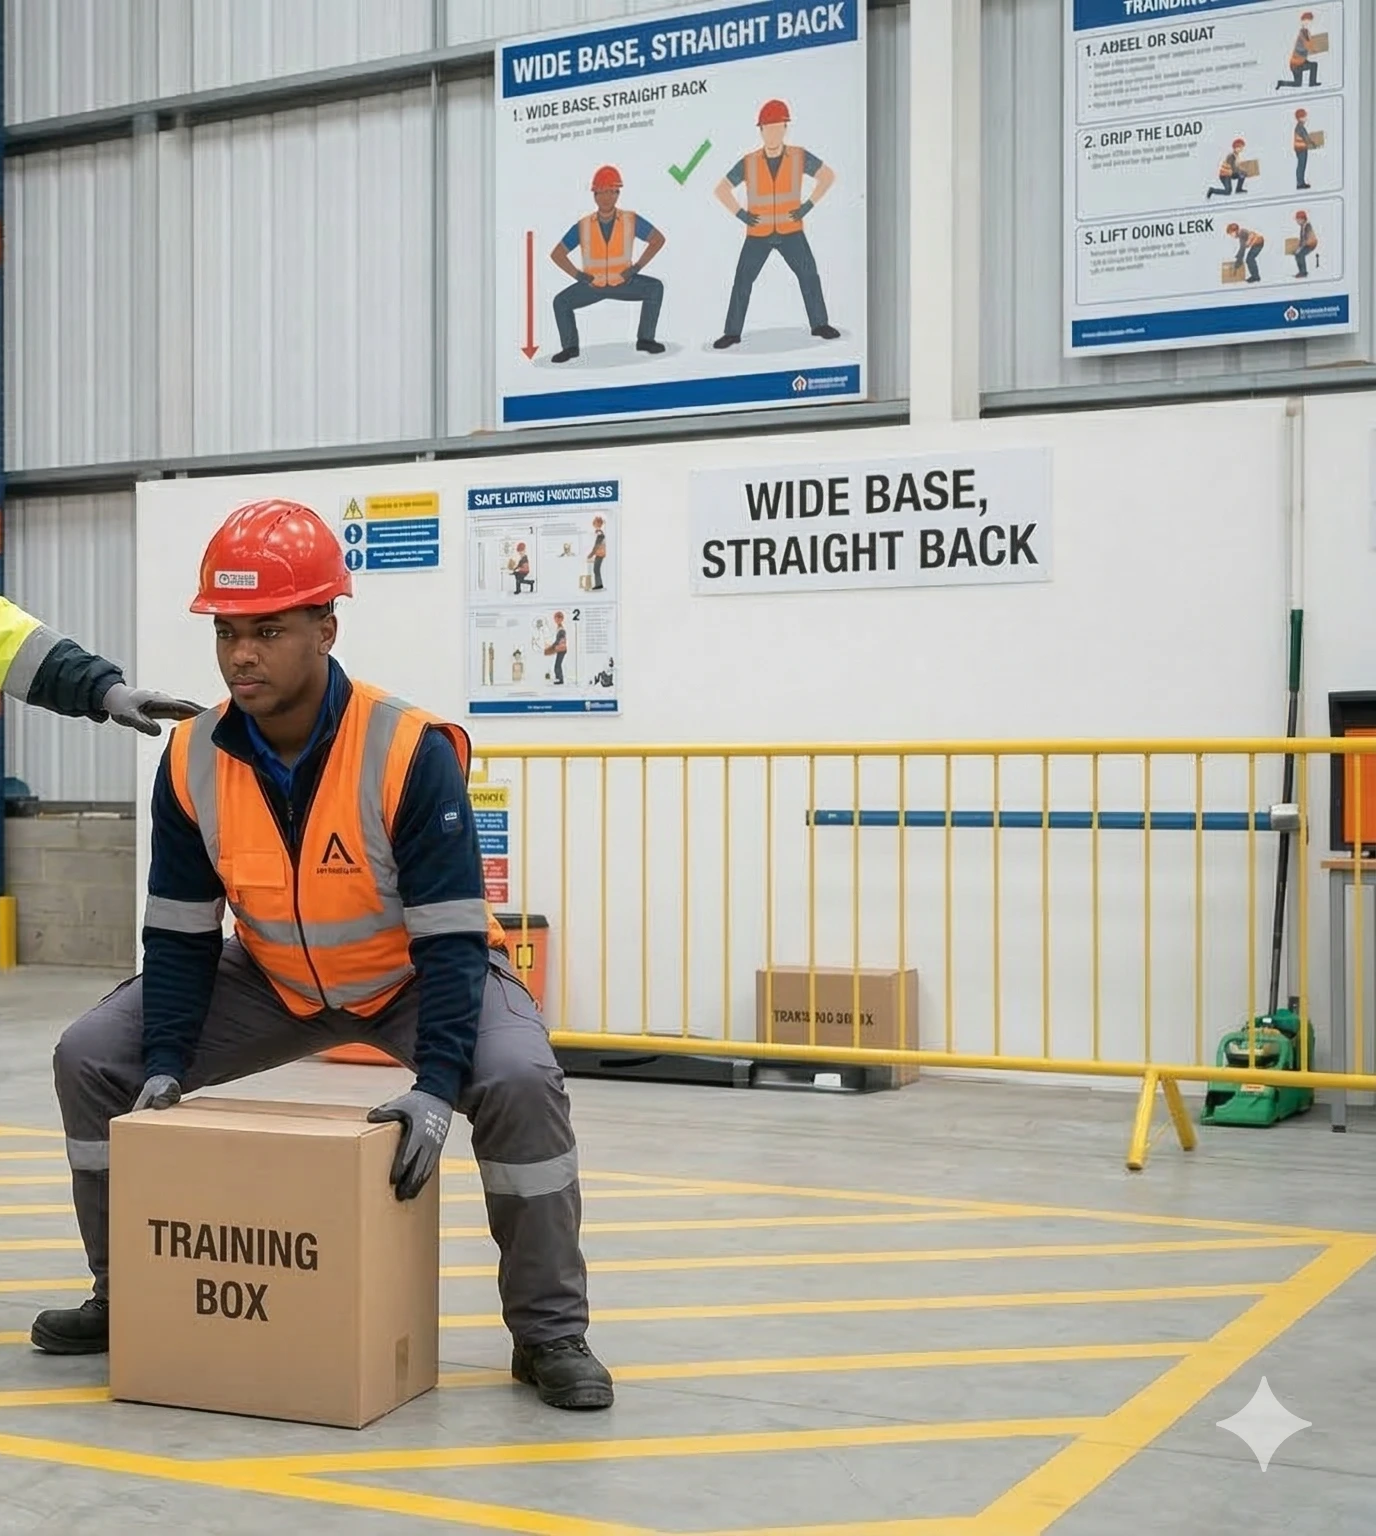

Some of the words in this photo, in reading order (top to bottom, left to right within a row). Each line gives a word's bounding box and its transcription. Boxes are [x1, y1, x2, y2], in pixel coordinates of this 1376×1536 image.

[512, 50, 572, 84] WIDE
[578, 38, 645, 74] BASE,
[651, 16, 770, 61] STRAIGHT
[777, 2, 845, 40] BACK
[1085, 44, 1096, 57] 1.
[1147, 33, 1166, 48] OR
[1170, 26, 1216, 46] SQUAT
[525, 101, 559, 120] WIDE
[602, 85, 667, 109] STRAIGHT
[672, 79, 708, 98] BACK
[1084, 136, 1096, 149] 2.
[1100, 130, 1132, 147] GRIP
[1136, 126, 1162, 142] THE
[1165, 121, 1203, 138] LOAD
[1100, 228, 1128, 244] LIFT
[474, 493, 502, 506] SAFE
[745, 477, 850, 521] WIDE
[865, 468, 988, 517] BASE,
[702, 530, 904, 579] STRAIGHT
[920, 523, 1039, 569] BACK
[572, 608, 581, 621] 2
[147, 1218, 319, 1271] TRAINING
[196, 1278, 269, 1322] BOX
